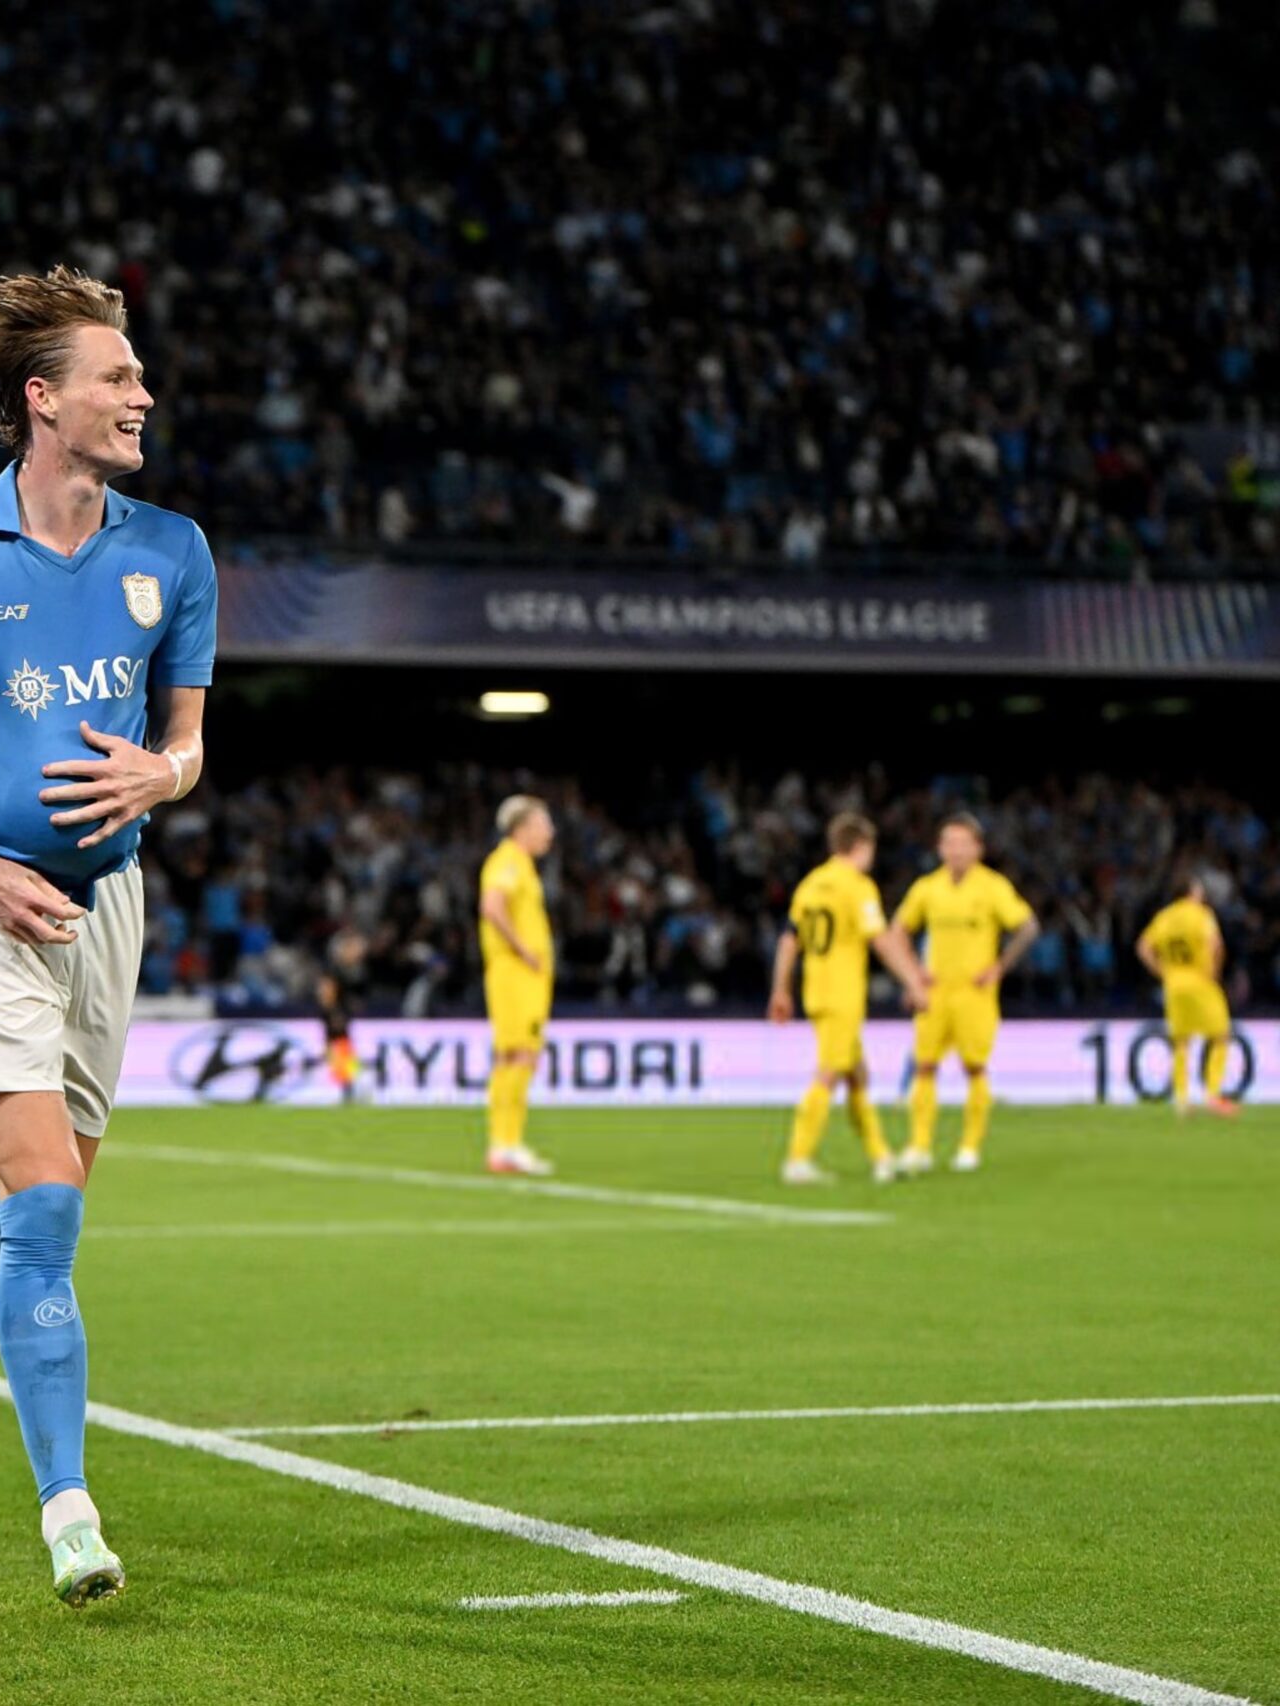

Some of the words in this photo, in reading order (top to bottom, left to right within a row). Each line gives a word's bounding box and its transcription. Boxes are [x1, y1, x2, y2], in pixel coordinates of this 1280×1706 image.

[485, 592, 590, 631] UEFA
[596, 594, 833, 638] CHAMPIONS
[838, 600, 991, 641] LEAGUE
